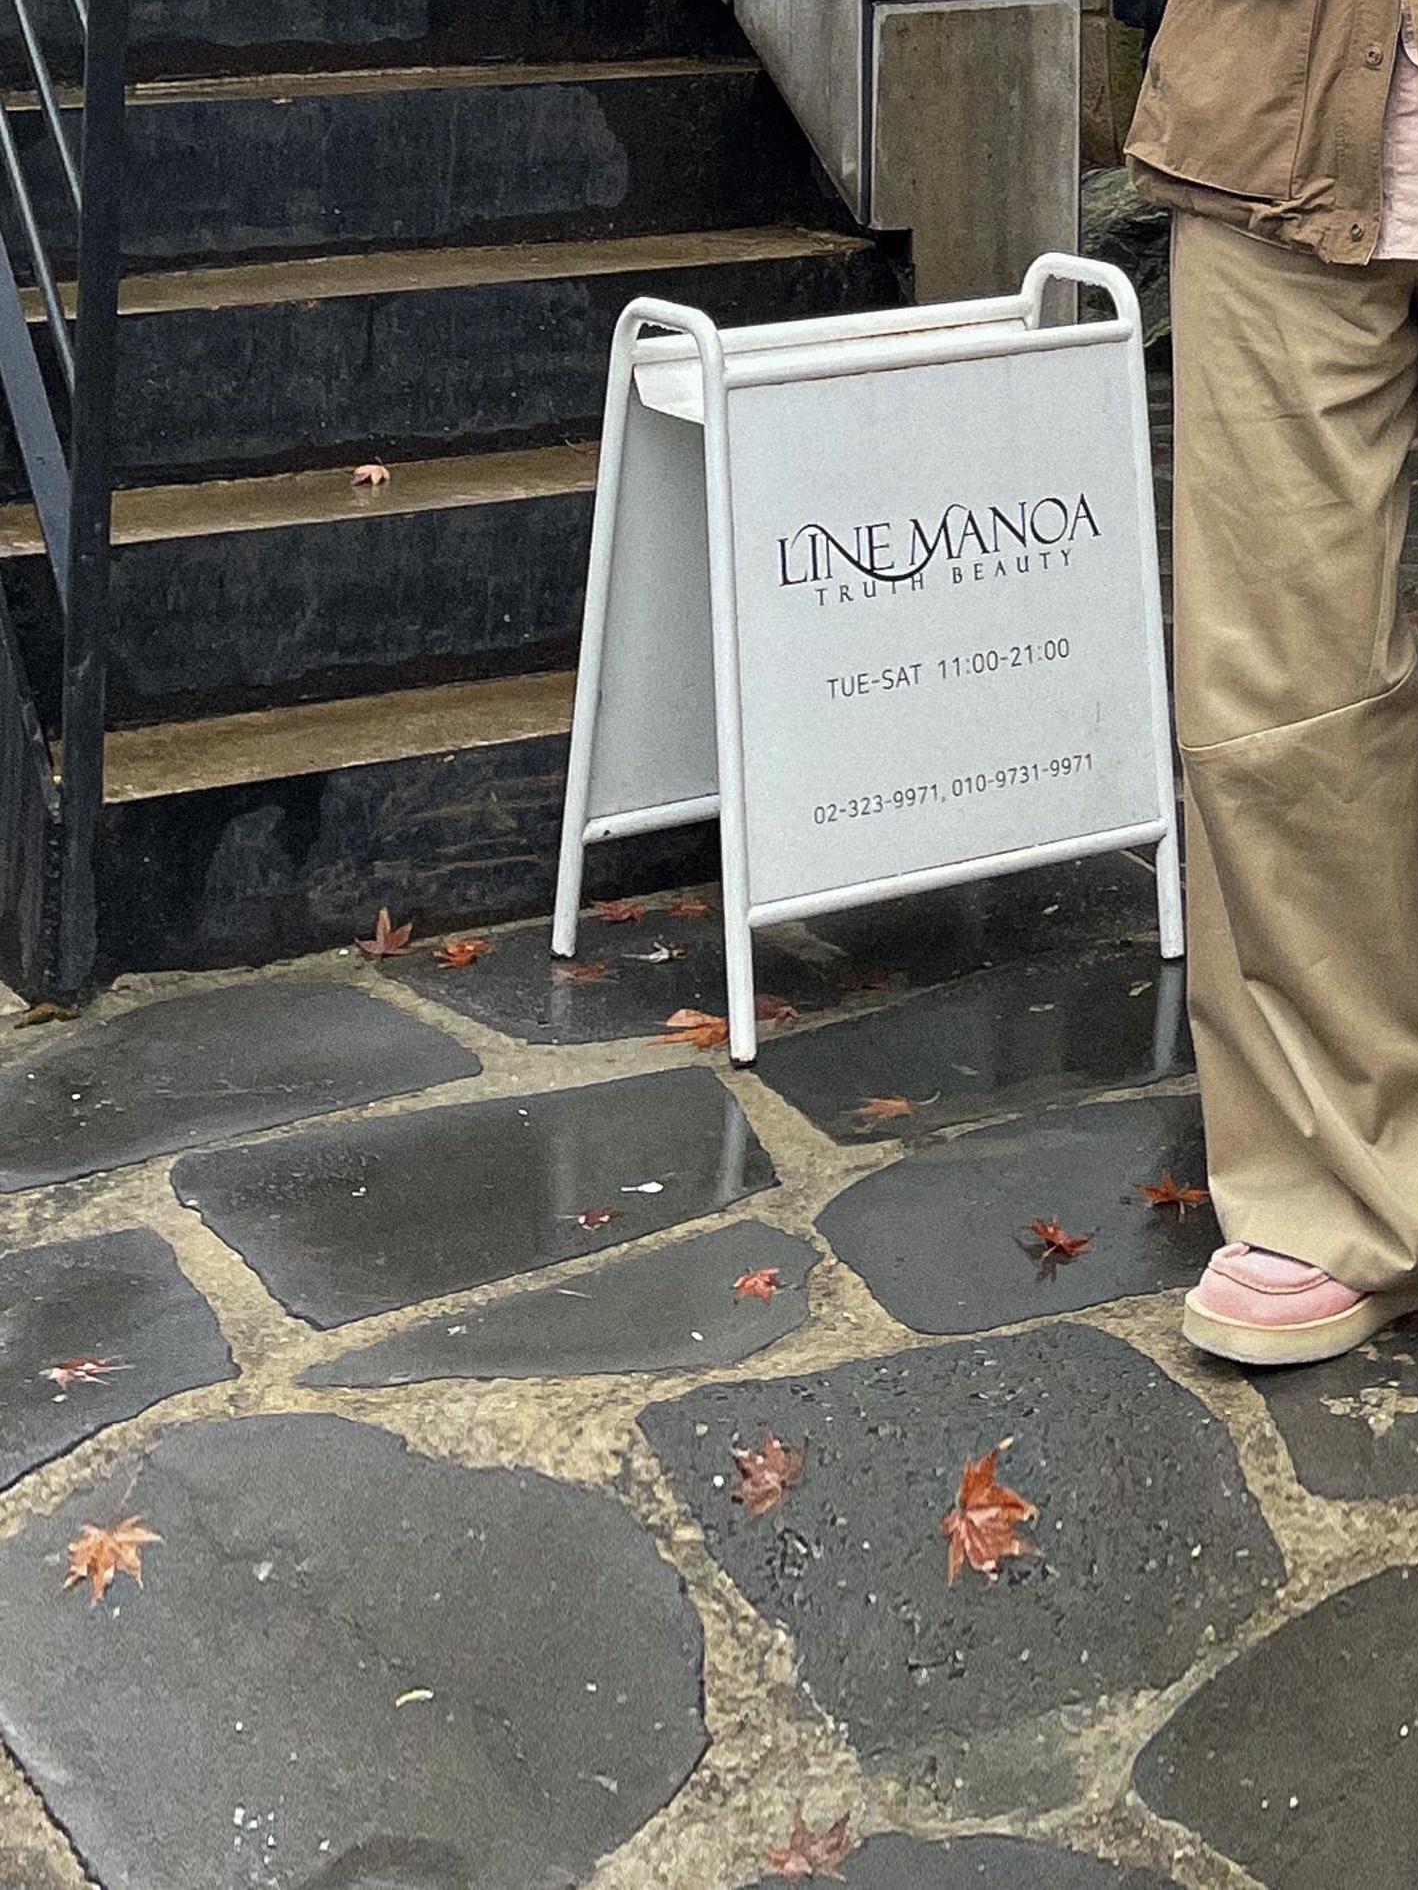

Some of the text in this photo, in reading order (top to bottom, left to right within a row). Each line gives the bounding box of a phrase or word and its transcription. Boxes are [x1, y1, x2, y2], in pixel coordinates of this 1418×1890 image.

[777, 493, 1101, 587] LINE MANOA
[815, 549, 1071, 606] TRUTH BEAUTY
[827, 638, 1069, 699] TUE-SAT 11:00-21:00
[951, 753, 1093, 797] 010-9731-9971
